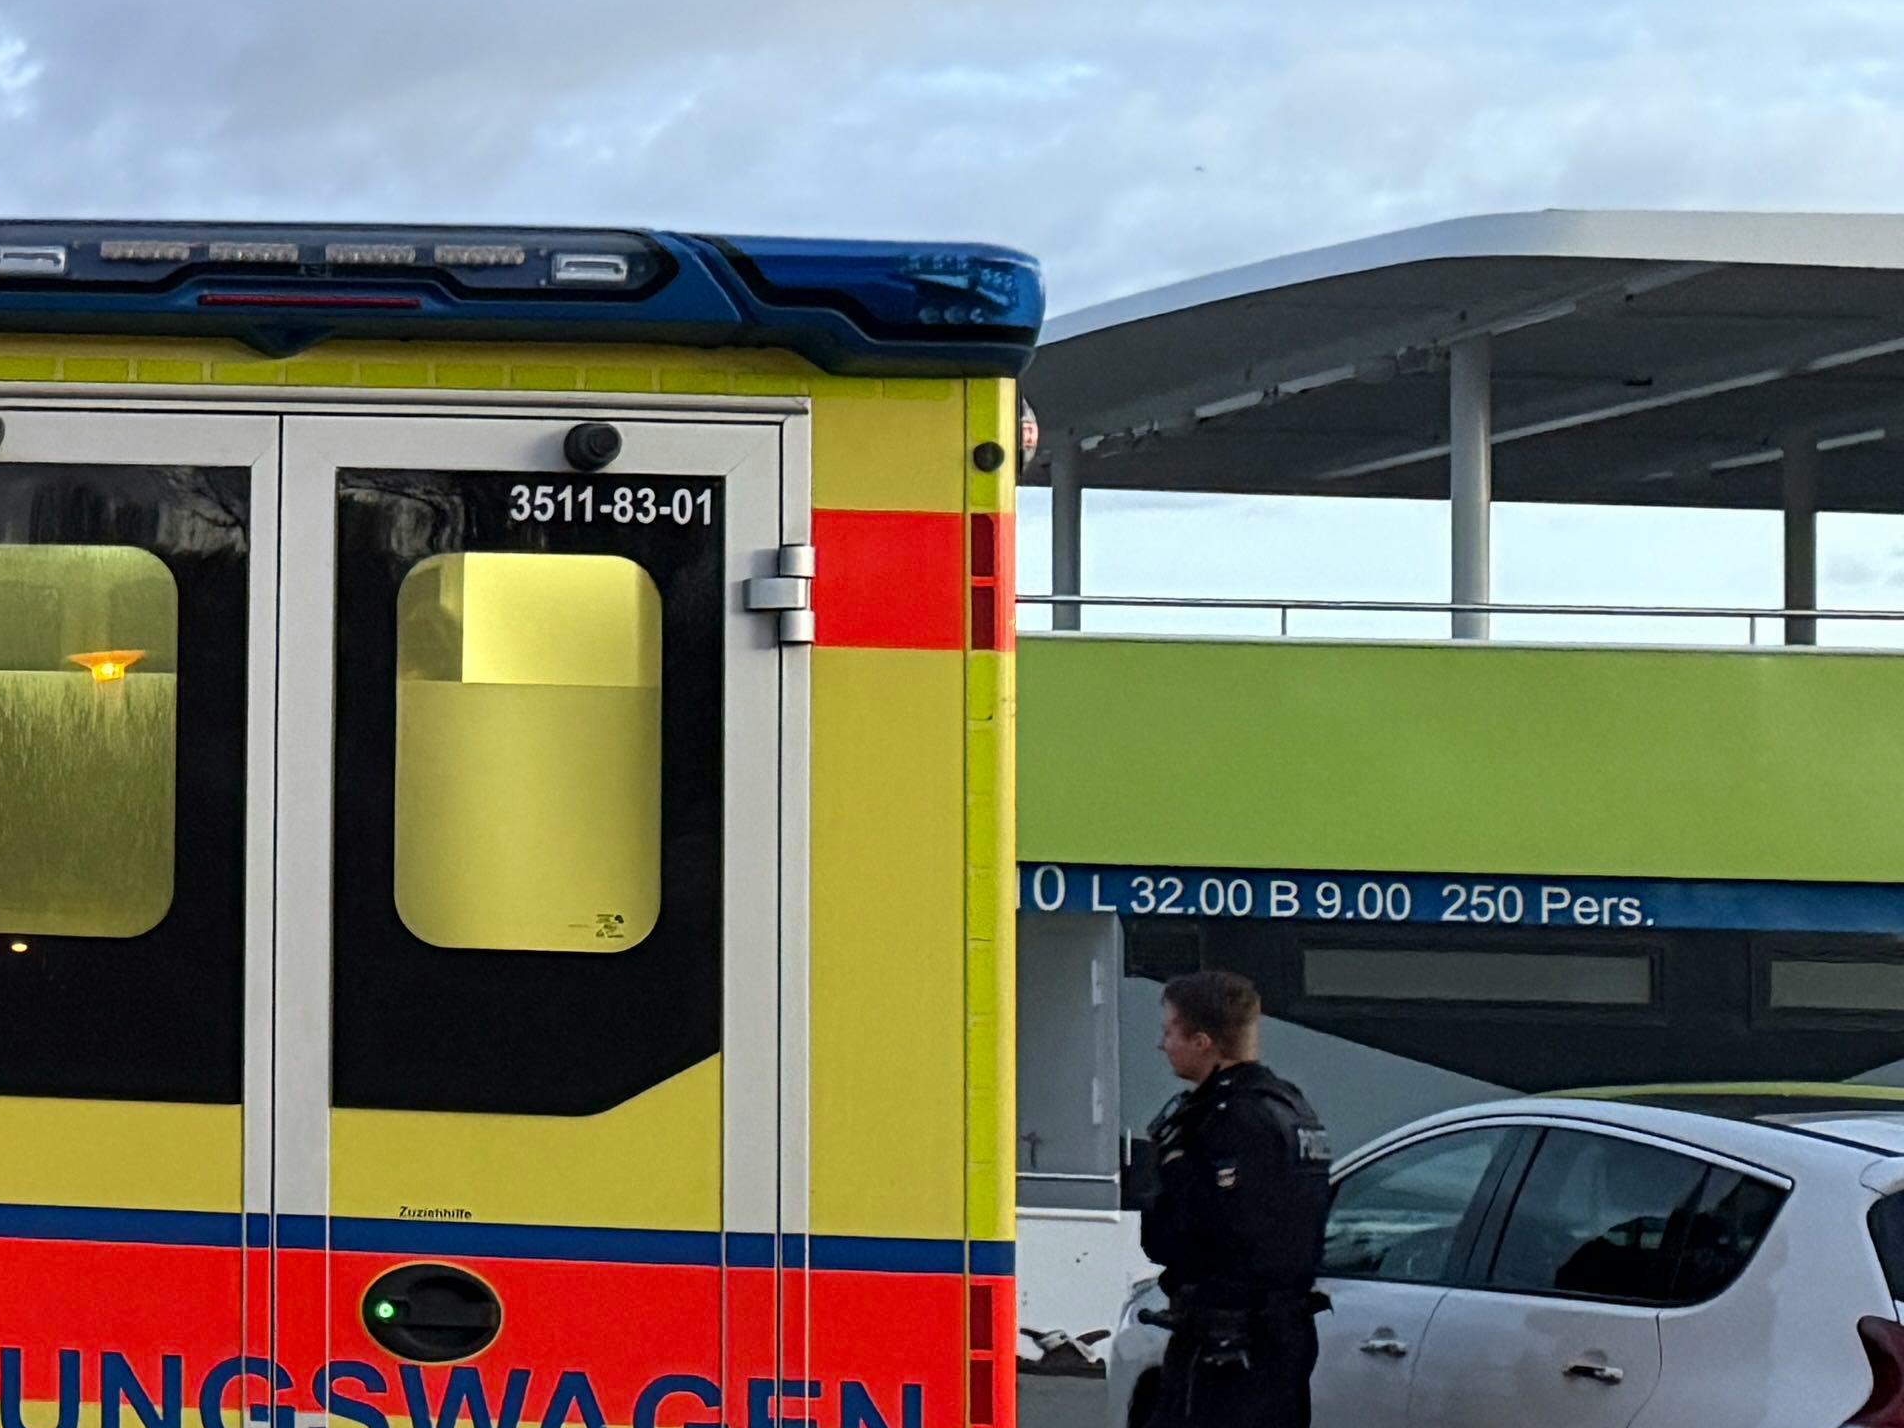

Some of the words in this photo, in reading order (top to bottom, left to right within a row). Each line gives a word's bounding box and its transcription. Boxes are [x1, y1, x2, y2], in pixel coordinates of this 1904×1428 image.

[510, 484, 712, 526] 3511-83-01
[1092, 874, 1118, 912] L
[1130, 876, 1253, 917] 32.00
[1269, 881, 1301, 917] B
[1314, 881, 1413, 921] 9.00
[1441, 885, 1524, 925] 250
[1539, 886, 1656, 927] Pers.
